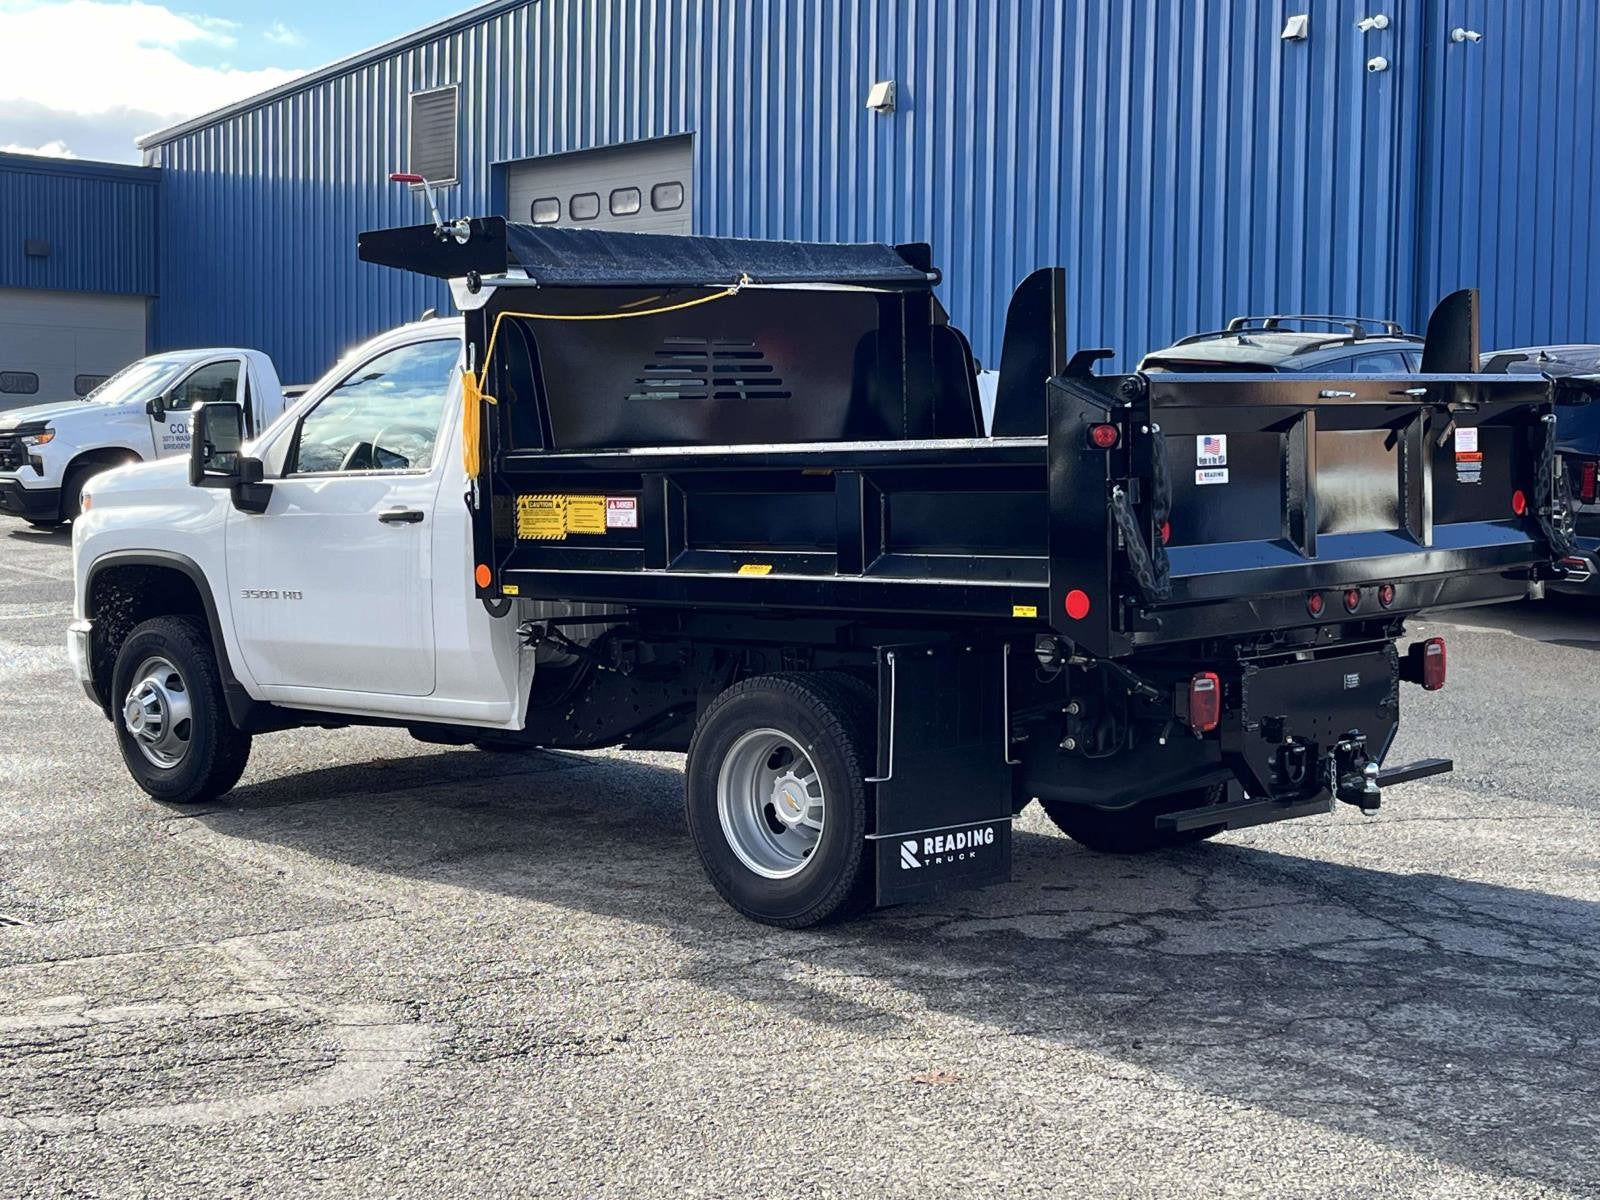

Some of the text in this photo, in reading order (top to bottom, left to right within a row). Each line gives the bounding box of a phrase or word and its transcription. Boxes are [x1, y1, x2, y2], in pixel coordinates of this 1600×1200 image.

[240, 590, 303, 600] 3500 HD
[924, 827, 994, 855] READING
[925, 851, 976, 866] TRUCK
